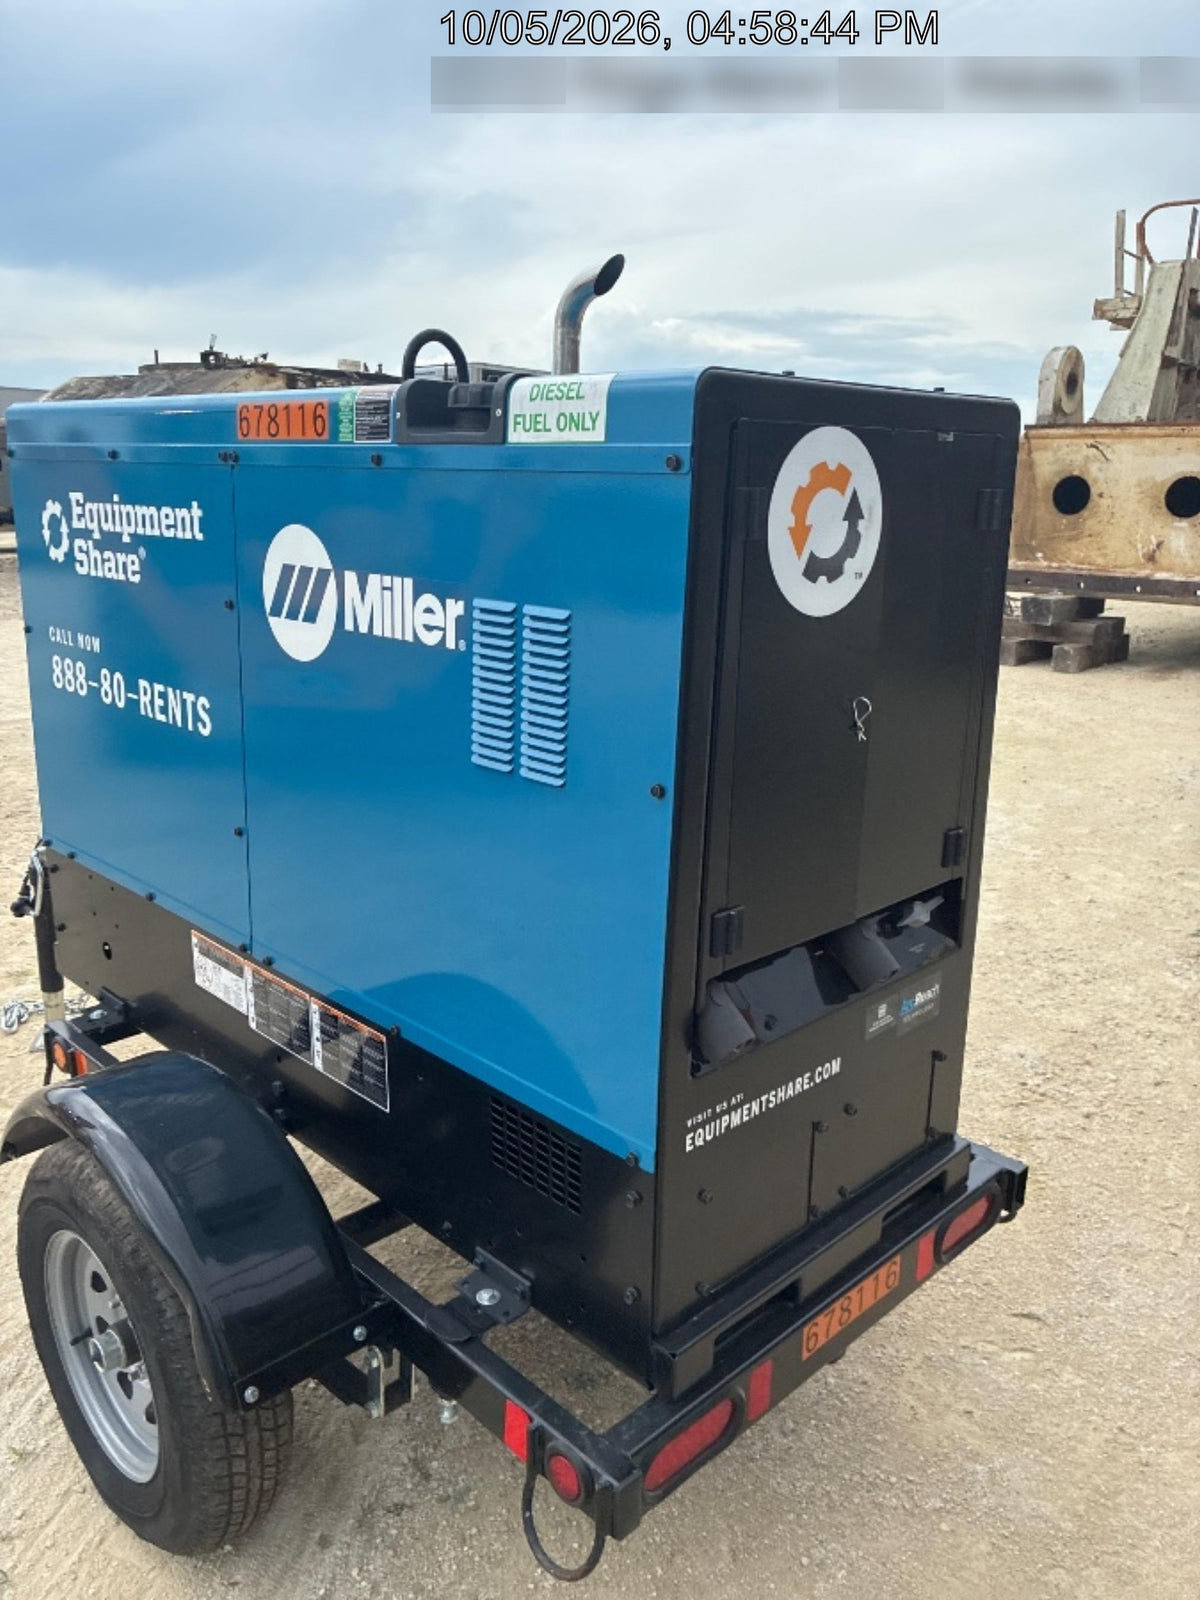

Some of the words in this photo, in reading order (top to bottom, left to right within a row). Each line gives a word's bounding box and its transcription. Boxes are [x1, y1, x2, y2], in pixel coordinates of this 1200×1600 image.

[529, 381, 585, 402] DIESEL
[239, 401, 325, 440] 678116
[513, 413, 551, 433] FUEL
[556, 410, 600, 432] ONLY
[69, 492, 204, 543] Equipment
[49, 626, 73, 647] CALL
[78, 632, 100, 653] NOW
[52, 654, 212, 737] 888-80-RENTS
[685, 1057, 841, 1152] EQUIPMENTSHARE.COM
[686, 1108, 712, 1128] VISIT
[716, 1101, 728, 1113] US
[806, 1260, 898, 1353] 678116
